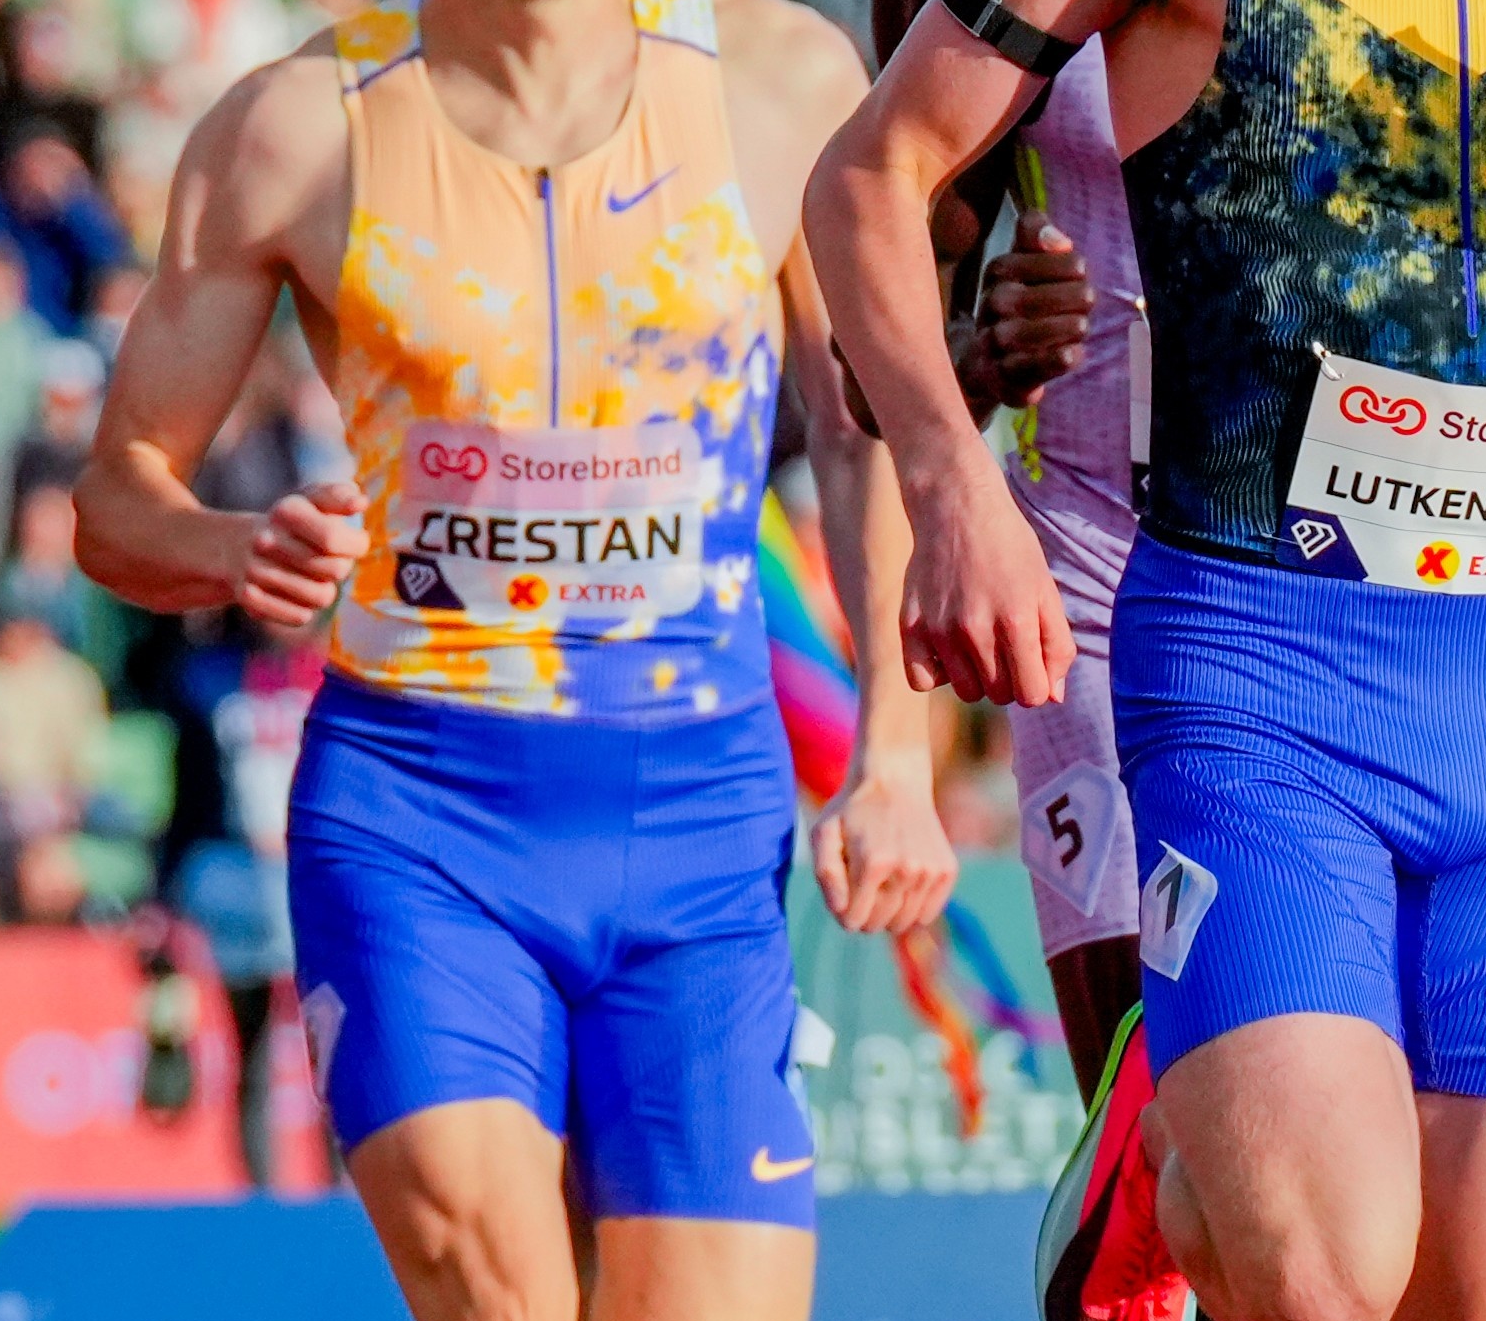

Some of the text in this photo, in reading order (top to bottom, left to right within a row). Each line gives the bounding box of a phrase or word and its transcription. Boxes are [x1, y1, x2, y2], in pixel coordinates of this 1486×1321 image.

[499, 448, 682, 482] Storebrand
[416, 511, 682, 563] CRESTAN
[559, 582, 647, 603] EXTRA
[1044, 792, 1085, 869] 5
